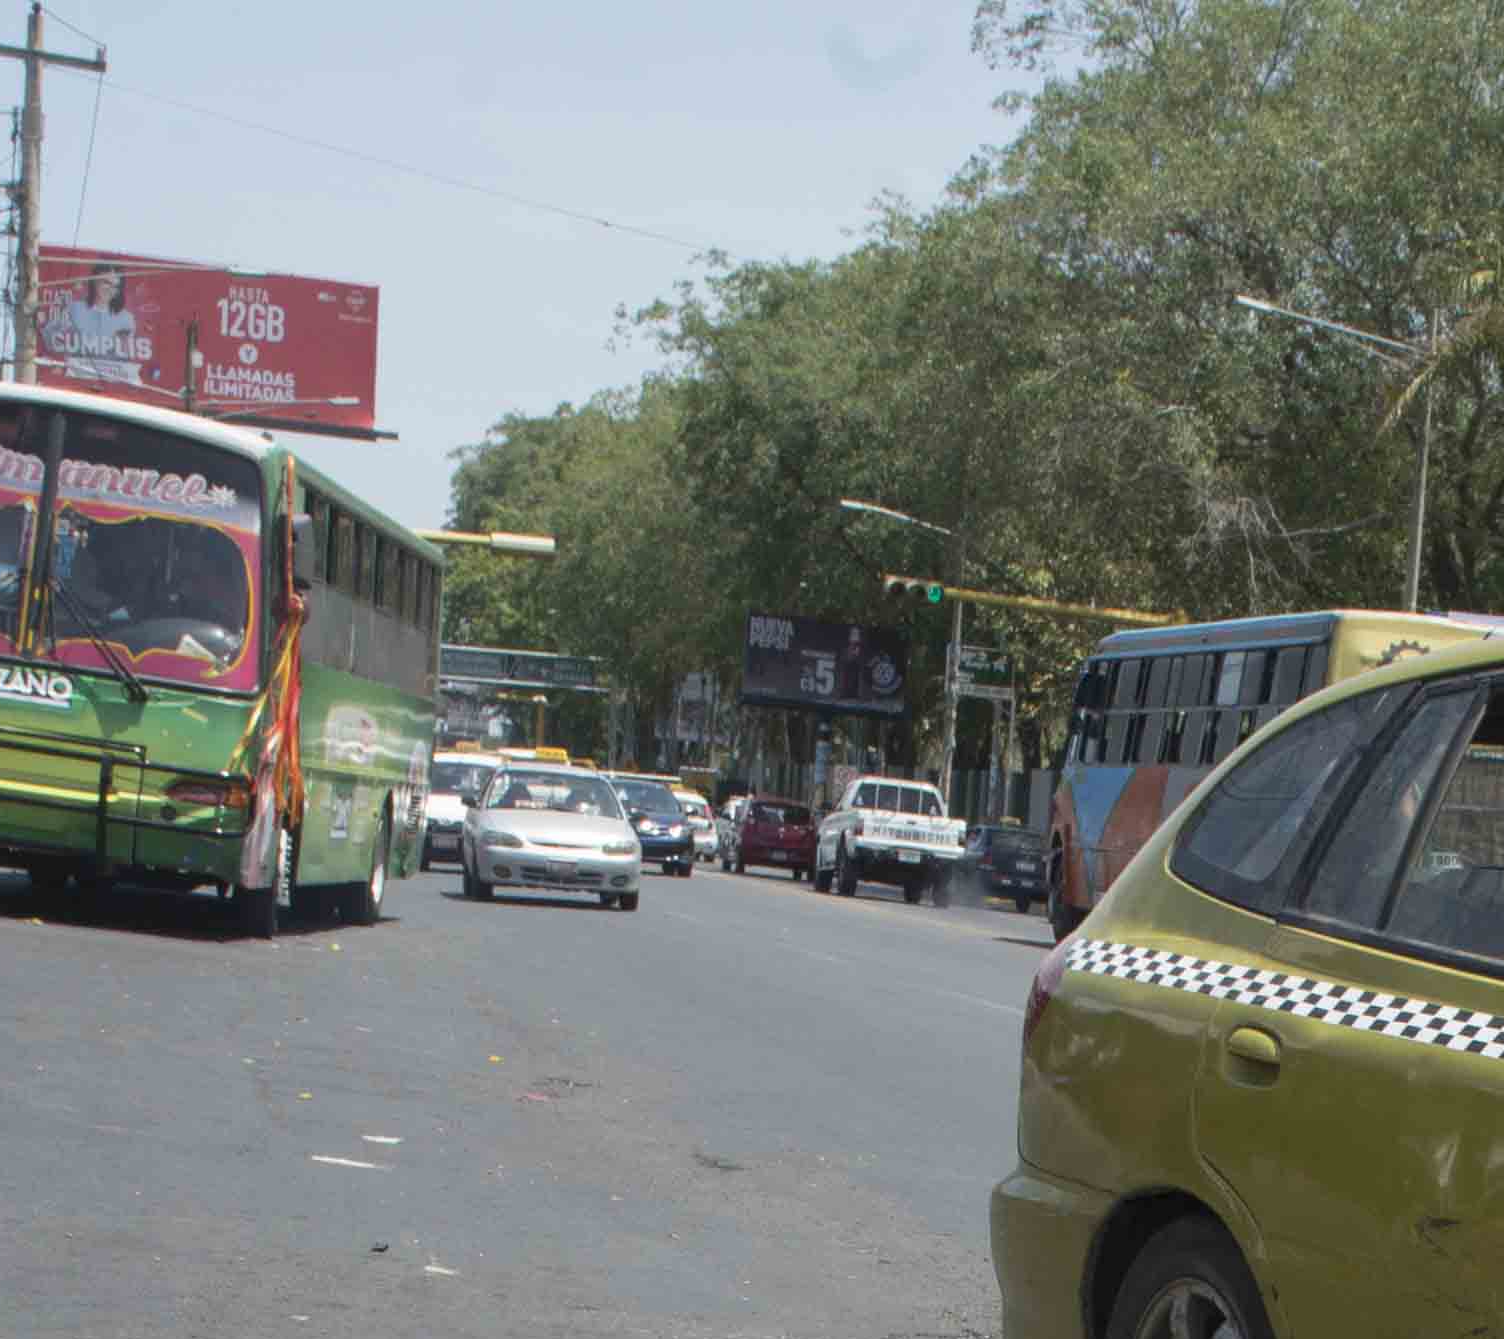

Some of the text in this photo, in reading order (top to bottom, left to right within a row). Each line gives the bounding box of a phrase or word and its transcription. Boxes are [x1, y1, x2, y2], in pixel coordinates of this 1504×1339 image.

[217, 297, 285, 343] 12GB
[207, 363, 296, 387] LLAMADAS
[204, 379, 295, 401] ILIMITADAS
